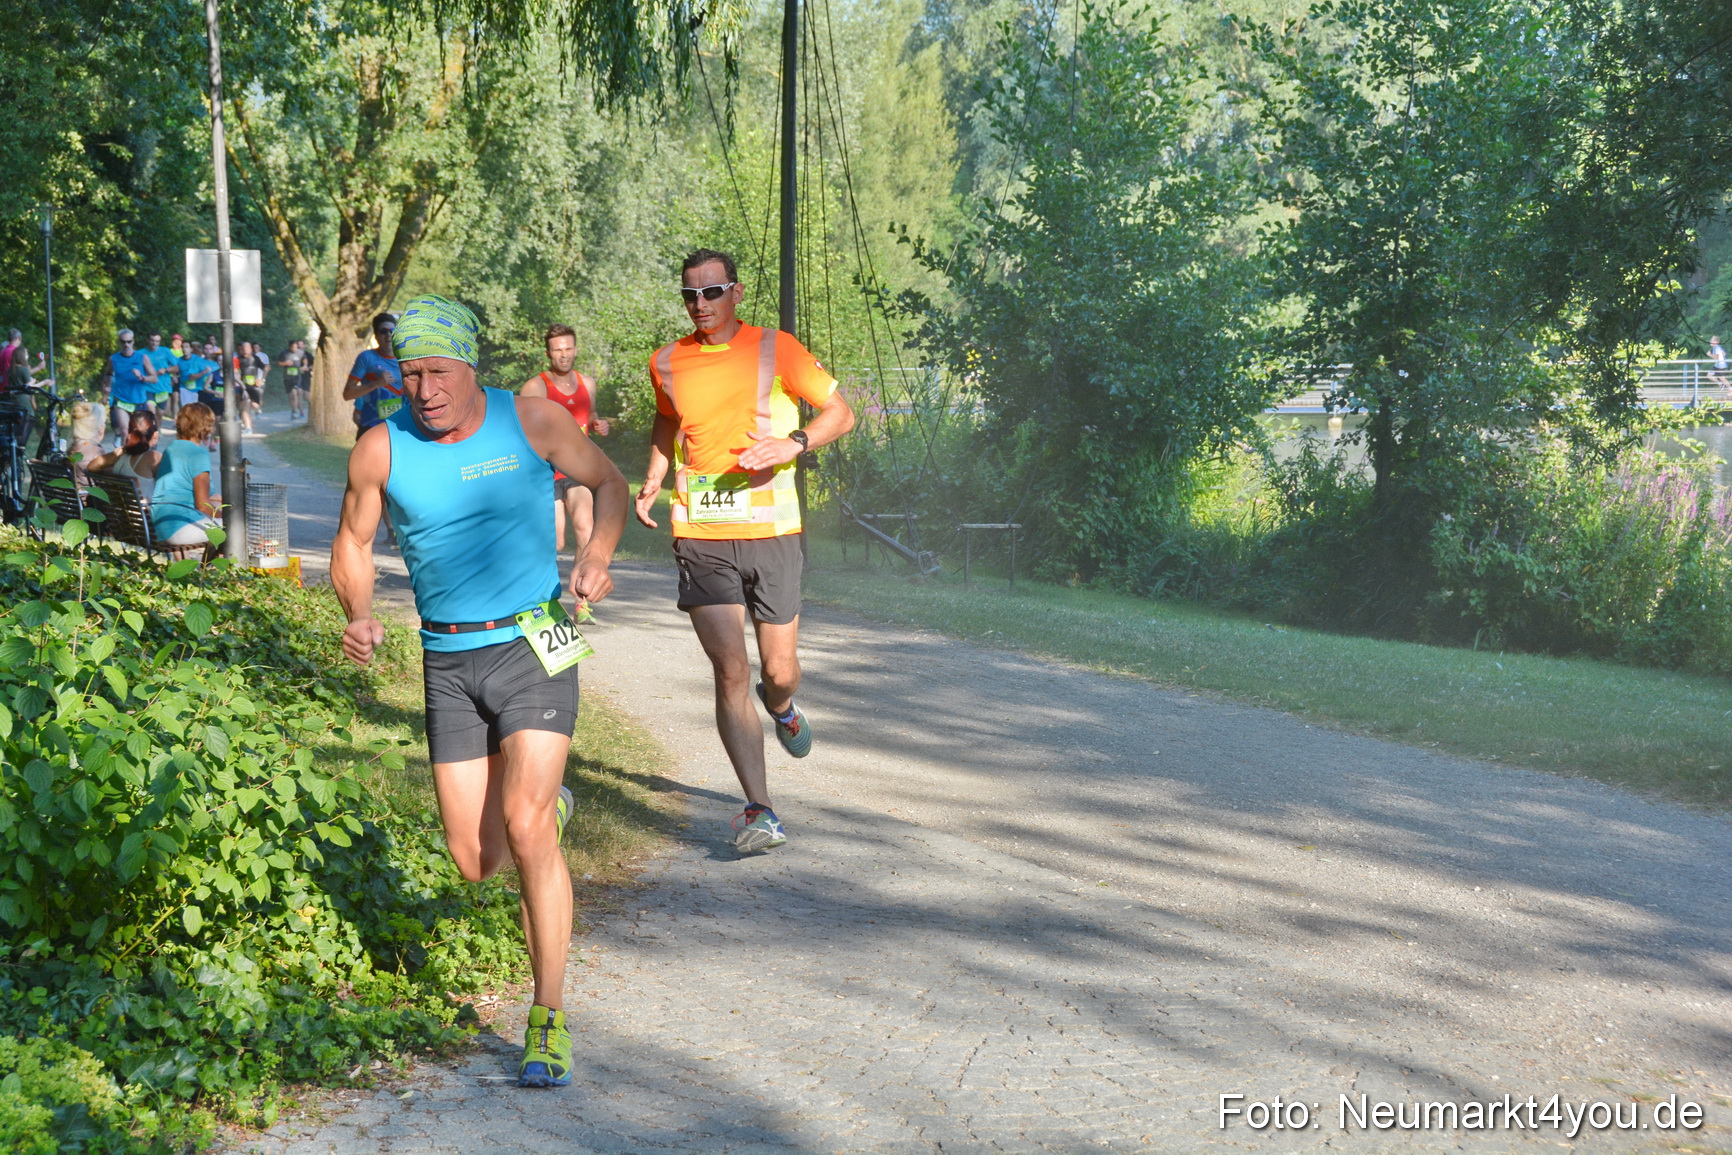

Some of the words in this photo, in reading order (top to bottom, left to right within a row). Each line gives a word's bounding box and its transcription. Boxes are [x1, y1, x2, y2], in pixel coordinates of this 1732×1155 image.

[462, 472, 481, 482] Peter
[482, 463, 520, 477] Blendinger
[700, 491, 735, 508] 444
[539, 618, 584, 655] 202
